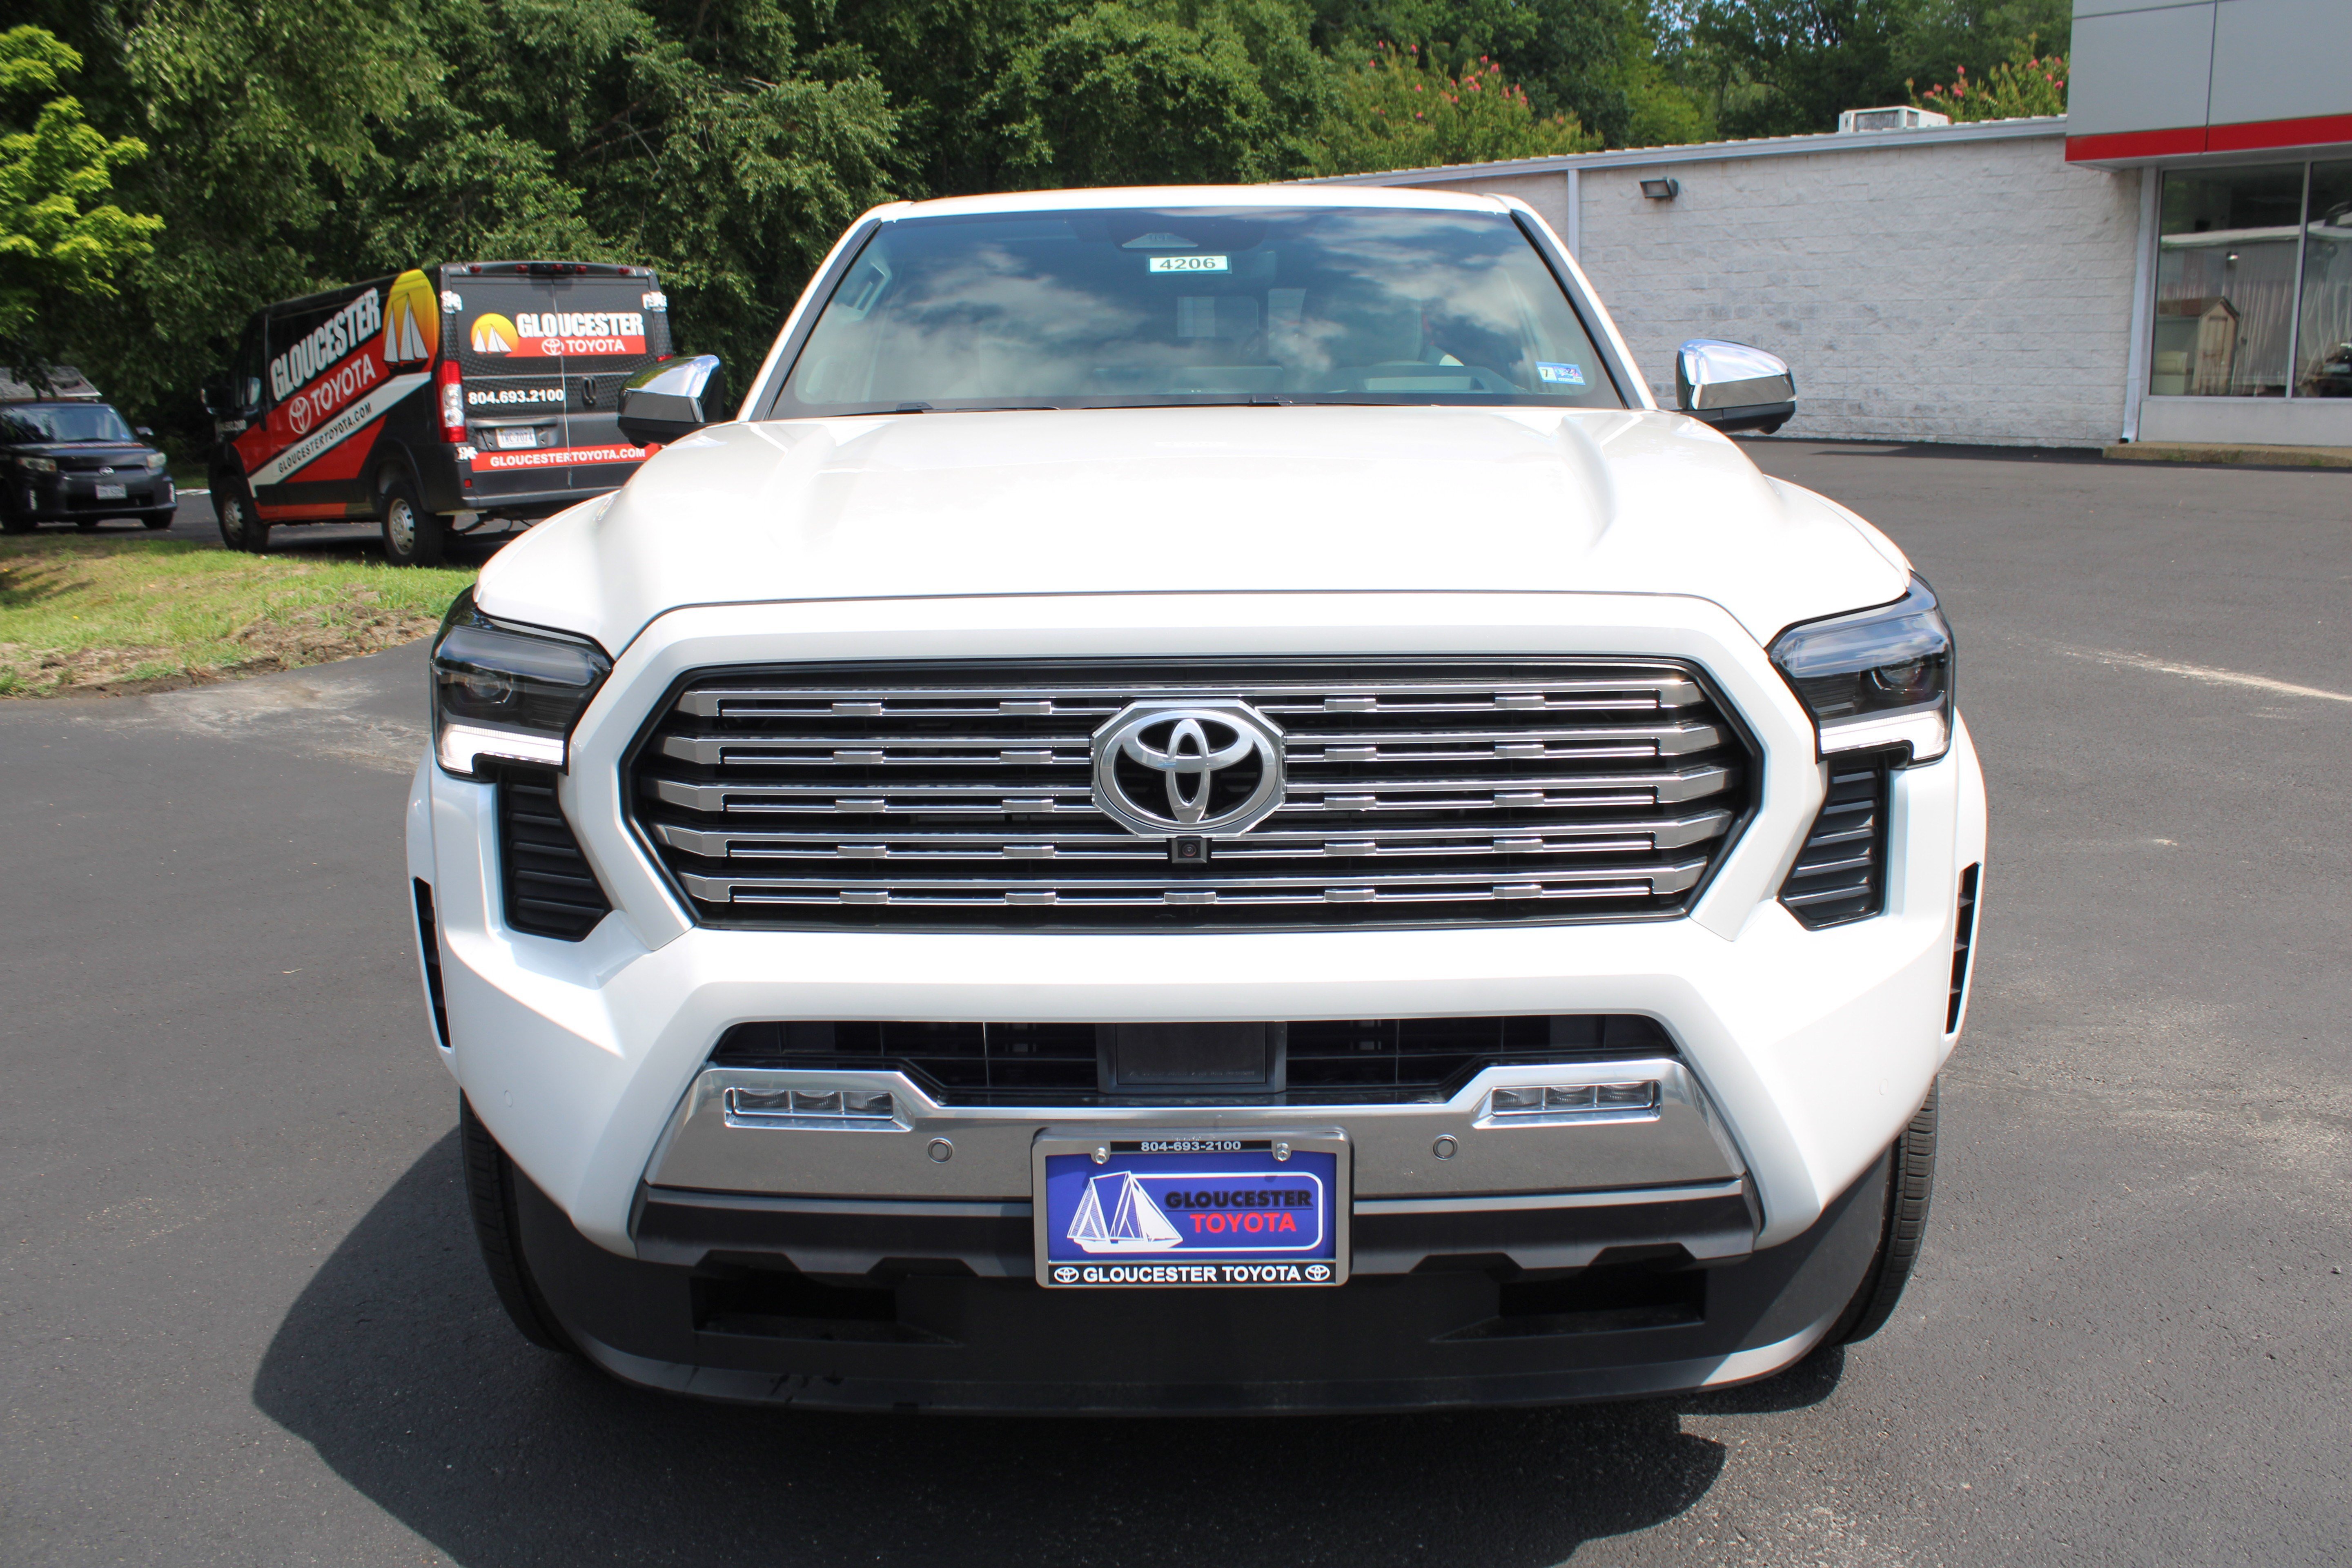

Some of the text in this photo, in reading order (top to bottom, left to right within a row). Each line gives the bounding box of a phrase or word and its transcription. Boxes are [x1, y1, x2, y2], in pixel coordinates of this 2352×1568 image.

[1160, 258, 1216, 270] 4206
[516, 312, 645, 338] GLOUCESTER
[270, 287, 381, 401] GLOUCESTER
[566, 339, 626, 353] TOYOTA
[310, 354, 376, 416] TOYOTA
[468, 389, 564, 405] 804.693.2100
[278, 402, 372, 473] GLOUCESTERTOYOTA.COM
[490, 448, 645, 467] GLOUCESTERTOYOTA.COM
[1141, 1141, 1241, 1152] 804-693-2100
[1165, 1190, 1313, 1209] GLOUCESTER
[1189, 1212, 1296, 1233] TOYOTA
[1083, 1266, 1301, 1283] GLOUCESTER TOYOTA
